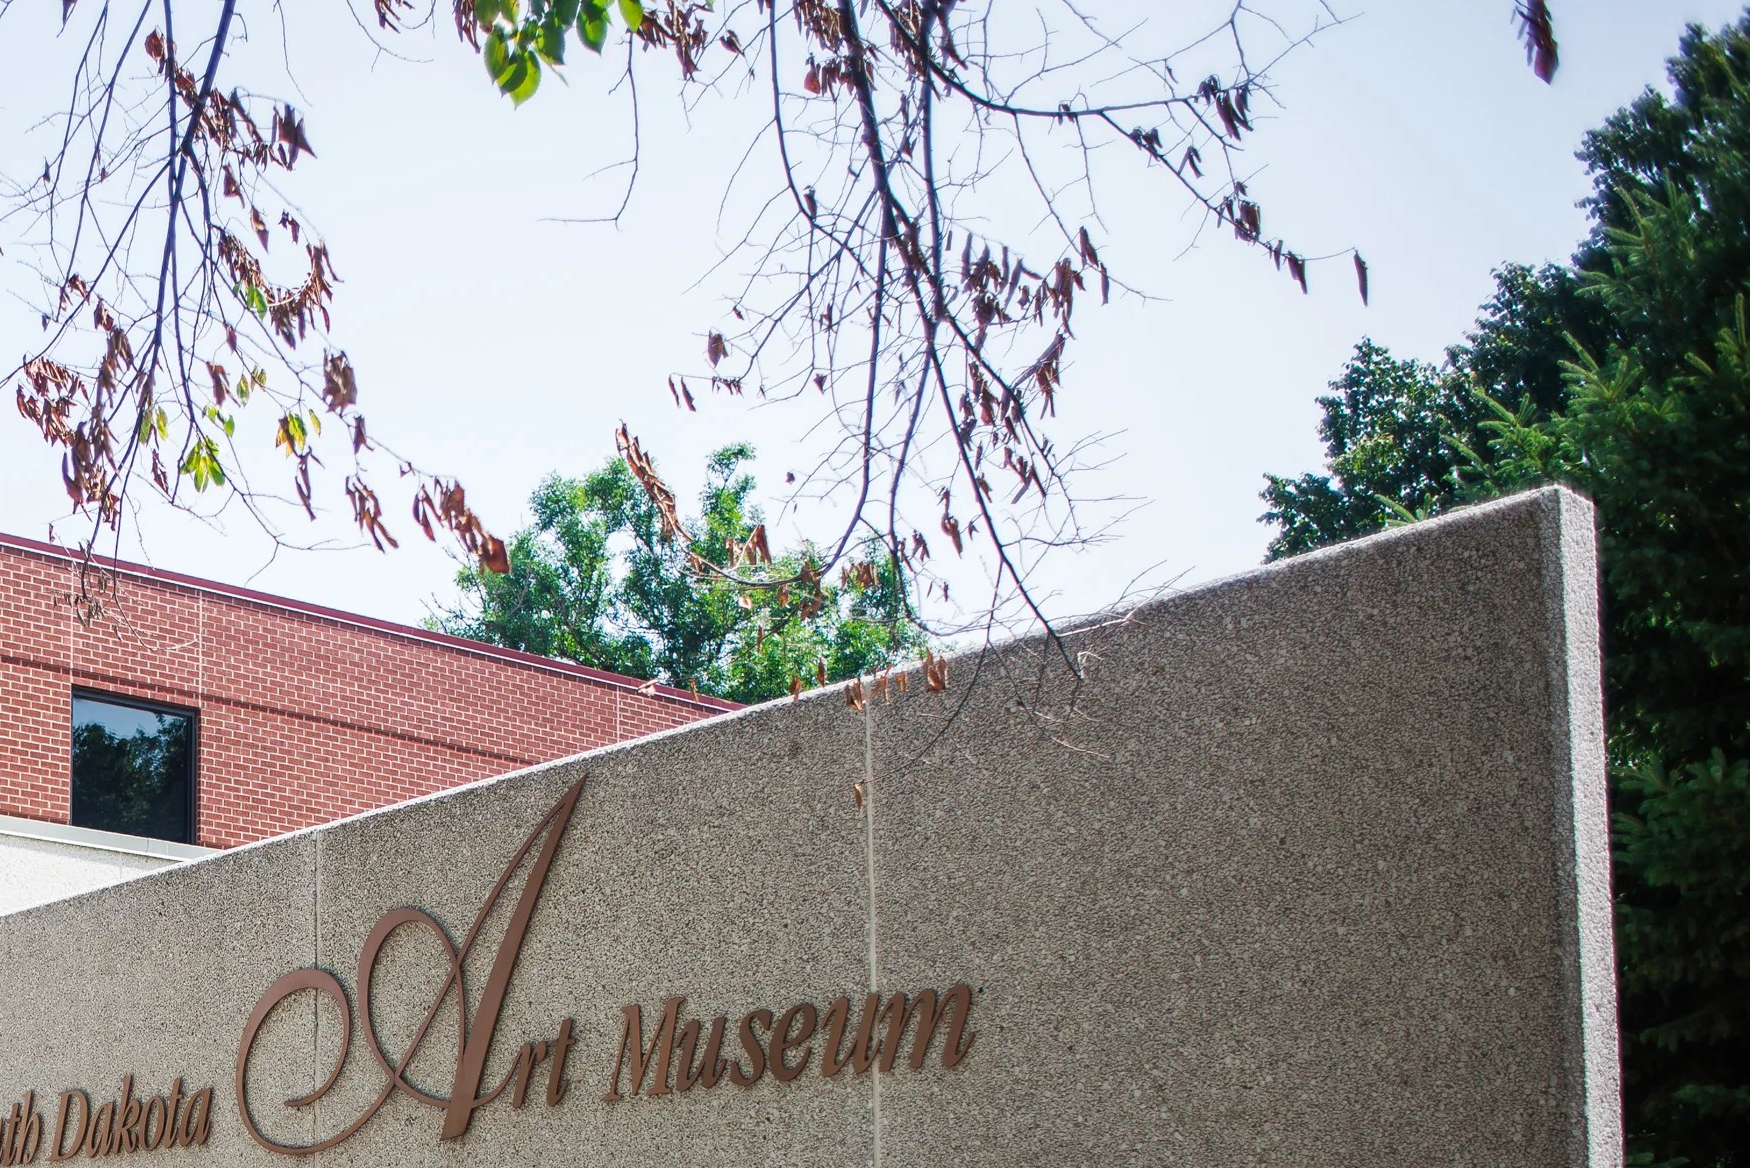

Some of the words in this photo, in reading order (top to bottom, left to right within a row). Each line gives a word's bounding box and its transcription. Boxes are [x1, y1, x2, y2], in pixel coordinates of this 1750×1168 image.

[50, 1072, 214, 1161] Dakota
[236, 773, 586, 1156] Art
[604, 983, 978, 1101] Museum
